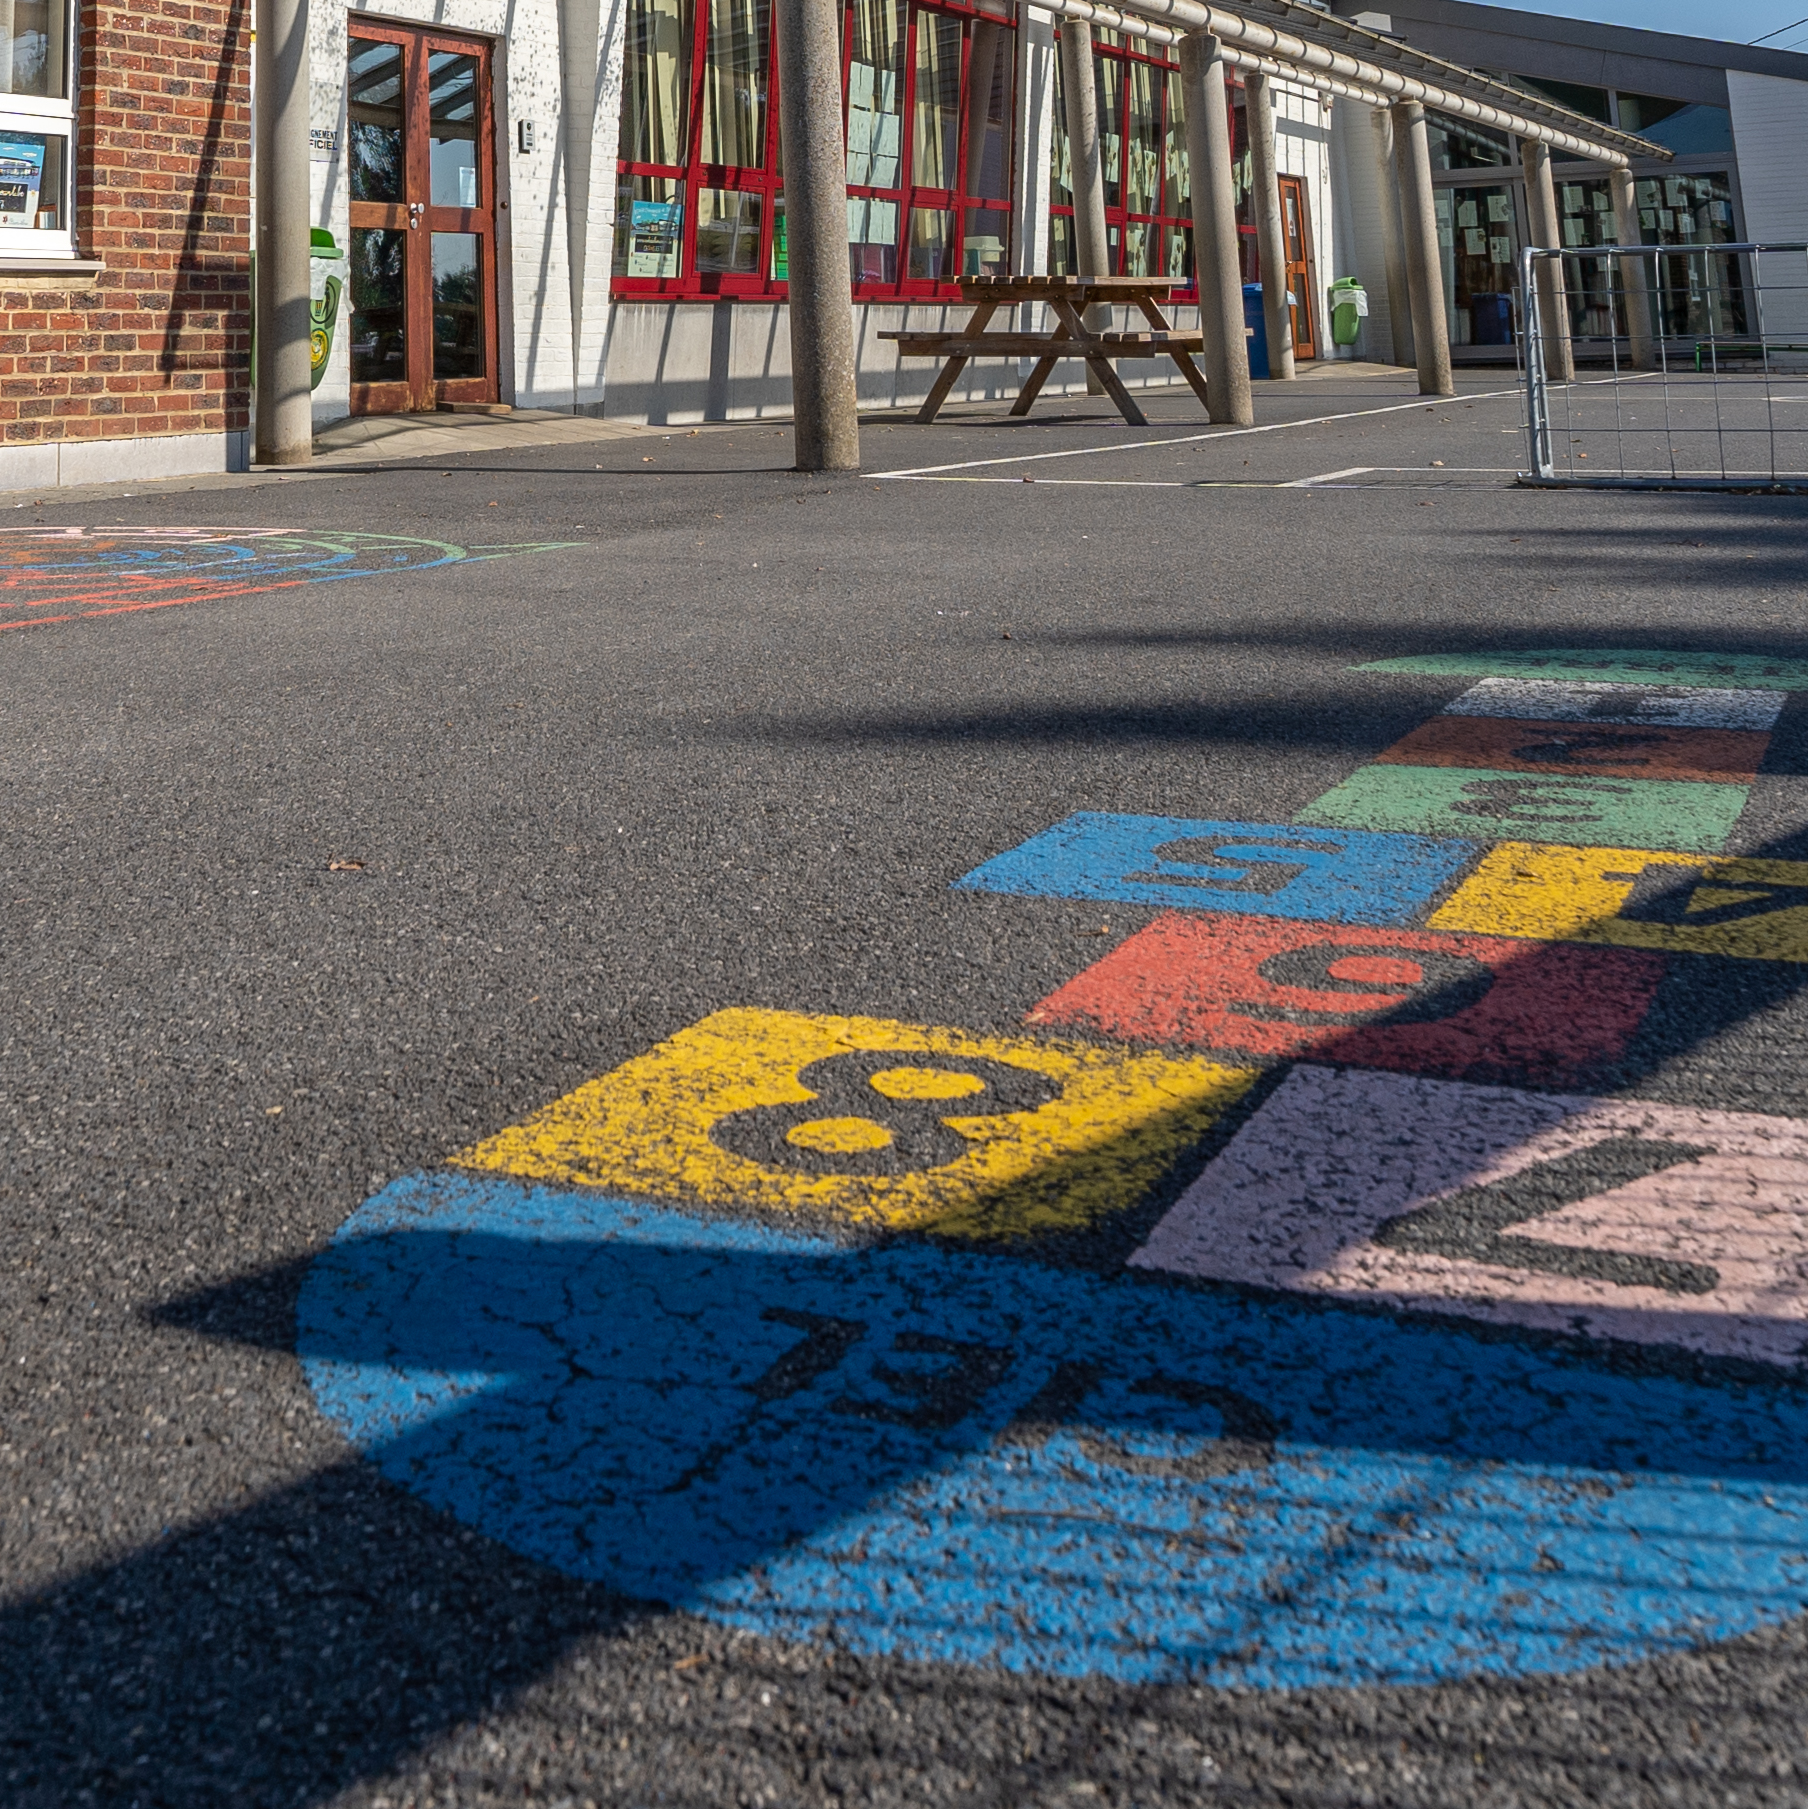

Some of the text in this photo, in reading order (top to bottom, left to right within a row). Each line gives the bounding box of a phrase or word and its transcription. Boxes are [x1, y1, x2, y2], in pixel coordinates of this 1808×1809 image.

[1510, 728, 1669, 765] 2
[1448, 778, 1633, 823] 3
[1122, 835, 1345, 894] 5
[708, 1049, 1721, 1296] 8 7
